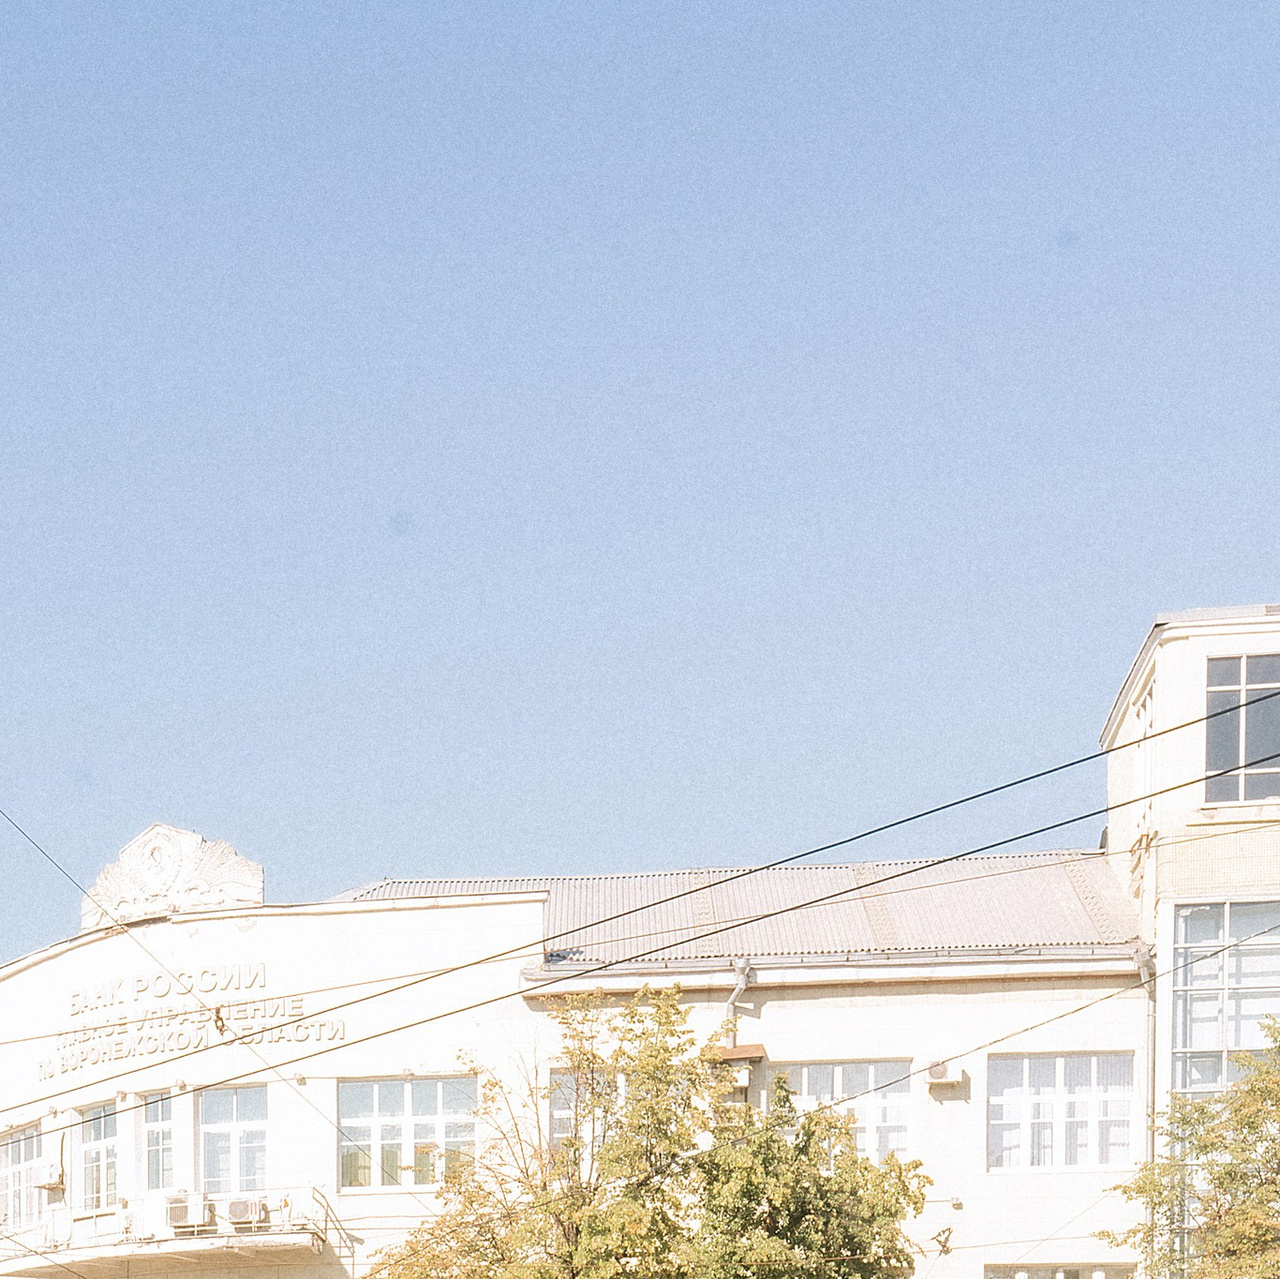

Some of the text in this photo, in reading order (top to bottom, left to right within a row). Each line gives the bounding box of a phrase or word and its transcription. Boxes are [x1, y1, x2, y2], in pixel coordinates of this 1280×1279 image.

[70, 962, 266, 1017] БАНК РОССИИ
[134, 997, 304, 1031] УПРАВЛЕНИЕ
[61, 1023, 209, 1074] ВОРОНЕЖСКОЙ
[222, 1019, 345, 1047] ОБЛАСТИ
